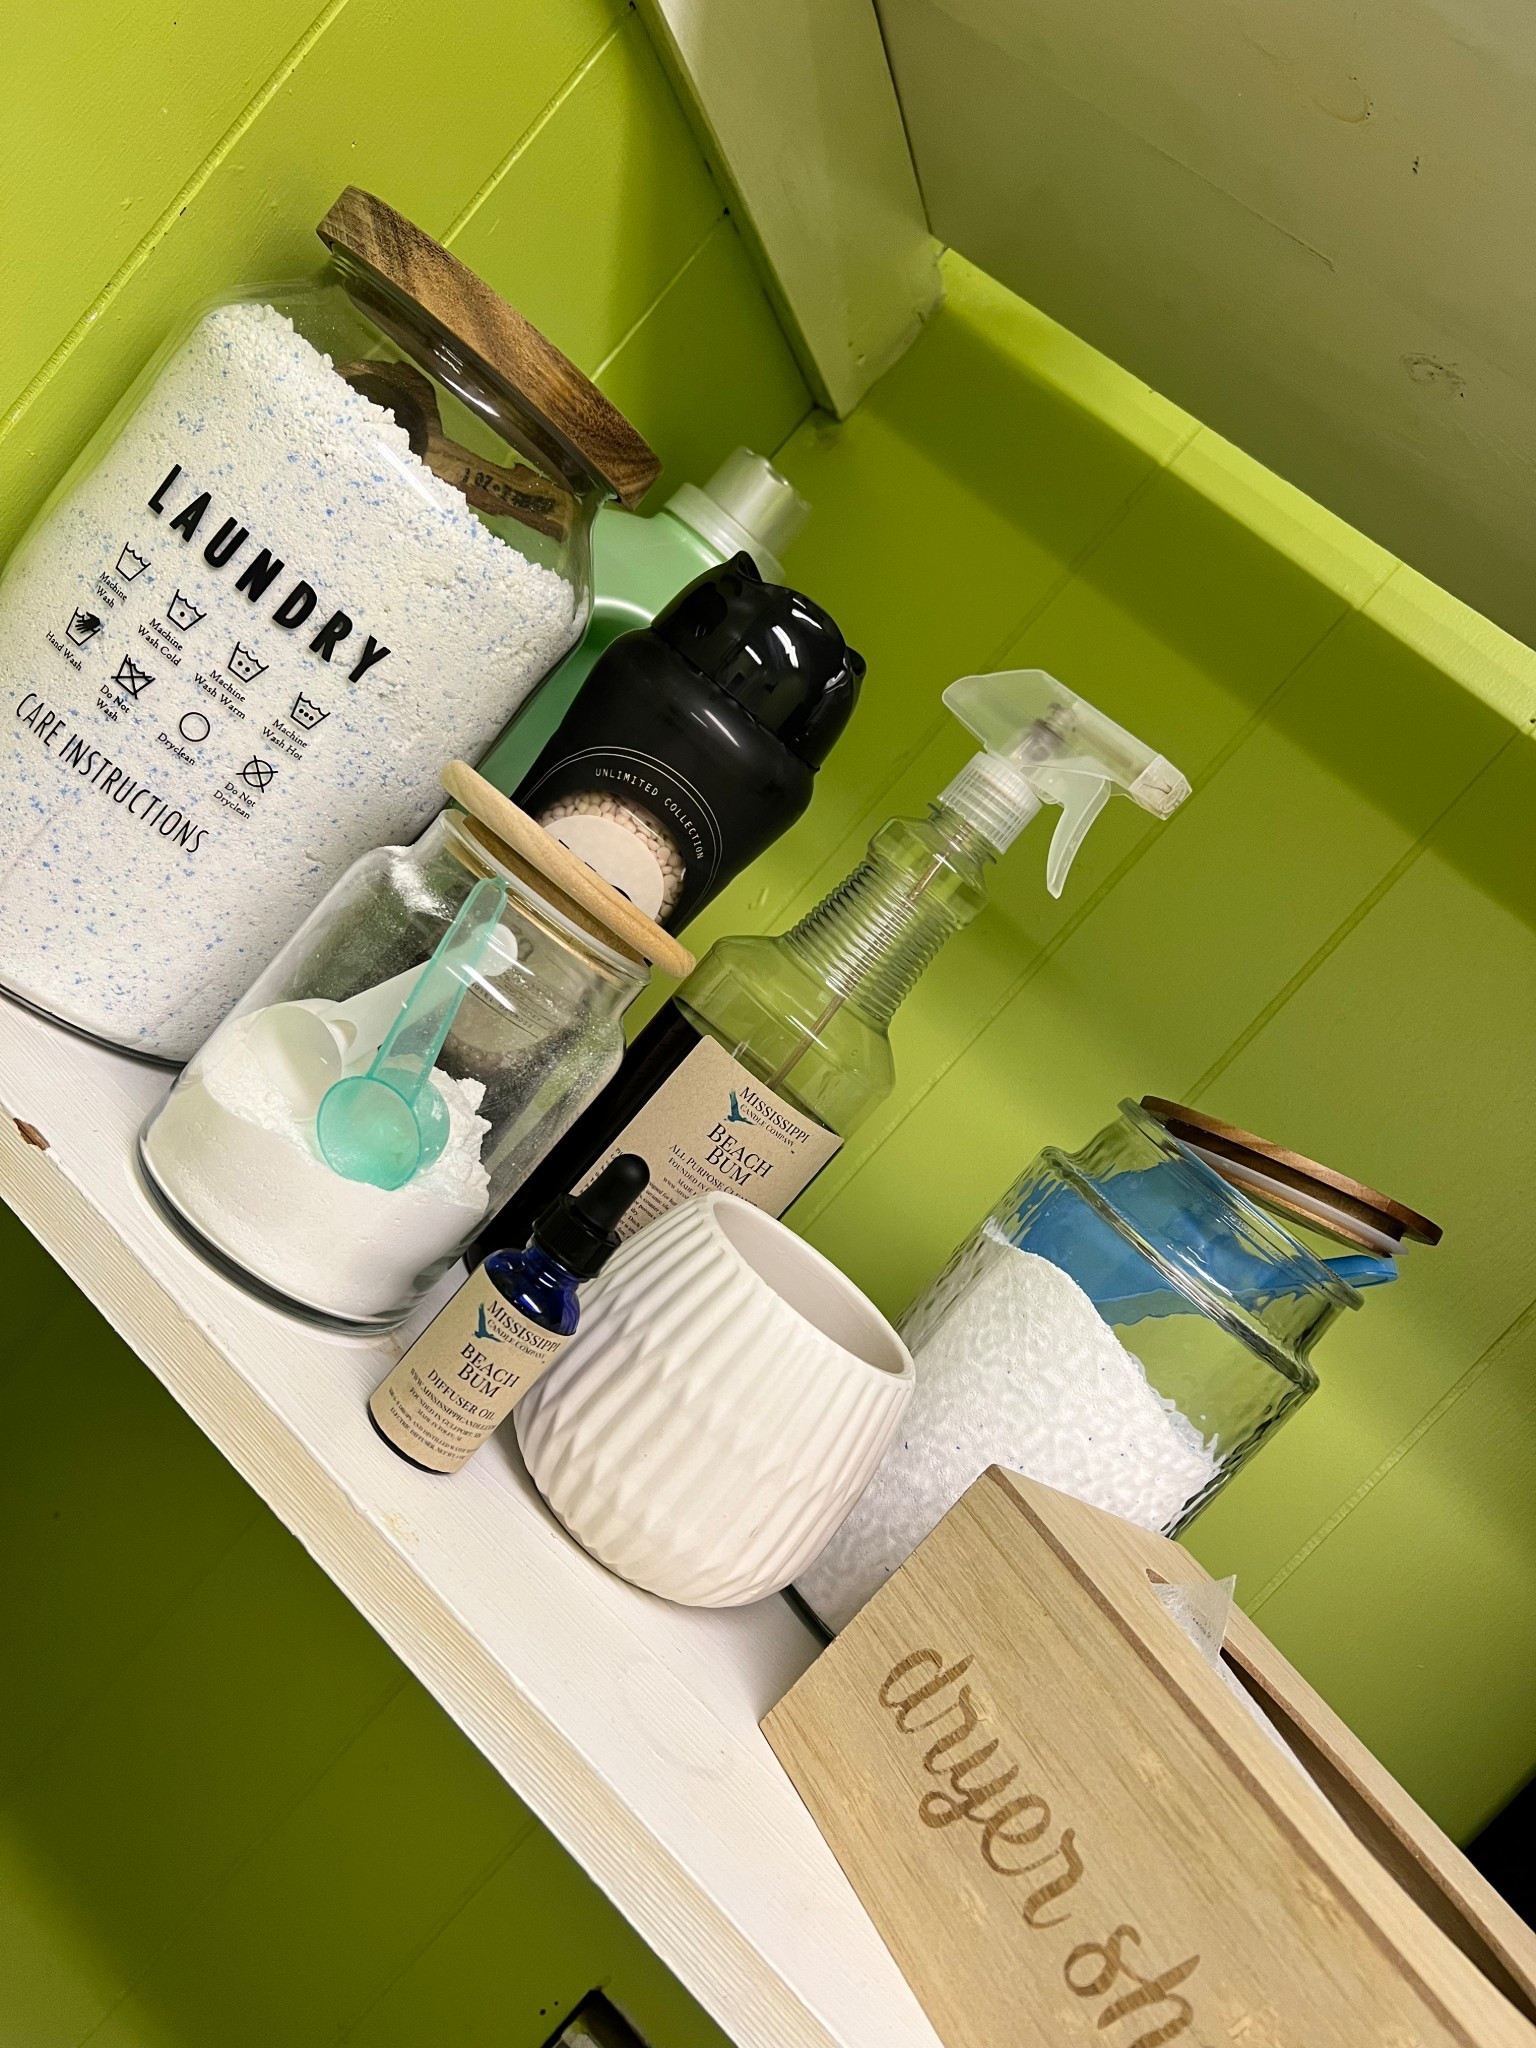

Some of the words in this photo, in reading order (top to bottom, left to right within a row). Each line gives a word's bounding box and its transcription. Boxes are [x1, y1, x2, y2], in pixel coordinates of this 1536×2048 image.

[99, 572, 127, 601] Machine
[148, 464, 391, 683] LAUNDRY
[97, 586, 114, 608] Wash
[46, 631, 64, 651] Hand
[64, 648, 81, 671] Wash
[138, 625, 158, 649] Wash
[160, 646, 181, 666] Cold
[149, 618, 182, 651] Machine
[100, 685, 112, 698] Do
[113, 696, 129, 713] Not
[195, 673, 216, 697] Wash
[220, 694, 245, 719] Warm
[210, 670, 245, 702] Machine
[97, 698, 117, 721] Wash
[158, 732, 195, 765] Dryclean
[263, 727, 284, 748] Wash
[282, 744, 302, 760] Hot
[272, 719, 307, 748] Machine
[17, 693, 66, 747] CARE
[59, 734, 209, 852] INSTRUCTIONS
[213, 790, 250, 819] Dryclean
[224, 782, 238, 794] Do
[239, 792, 255, 807] Not
[596, 769, 658, 795] UNLIMITED
[665, 798, 703, 858] COLLECTION
[740, 1087, 810, 1143] MISSISSIPPI
[740, 1104, 764, 1126] CANDLE
[766, 1125, 793, 1146] COMPANY
[670, 1145, 685, 1160] ALL
[686, 1158, 722, 1190] PURPOSE
[705, 1146, 752, 1186] BUM
[707, 1123, 773, 1177] BEACH
[668, 1158, 698, 1184] FOUNDED
[698, 1182, 704, 1190] IN
[488, 1300, 560, 1352] MISSISSIPPI
[488, 1320, 513, 1343] CANDLE
[515, 1342, 544, 1358] COMPANY
[458, 1363, 500, 1397] BUM
[460, 1343, 520, 1387] BEACH
[410, 1387, 434, 1414] FOUNDED
[428, 1370, 477, 1414] DIFFUSER
[478, 1409, 494, 1419] OIL
[878, 1648, 1083, 1928] dryer
